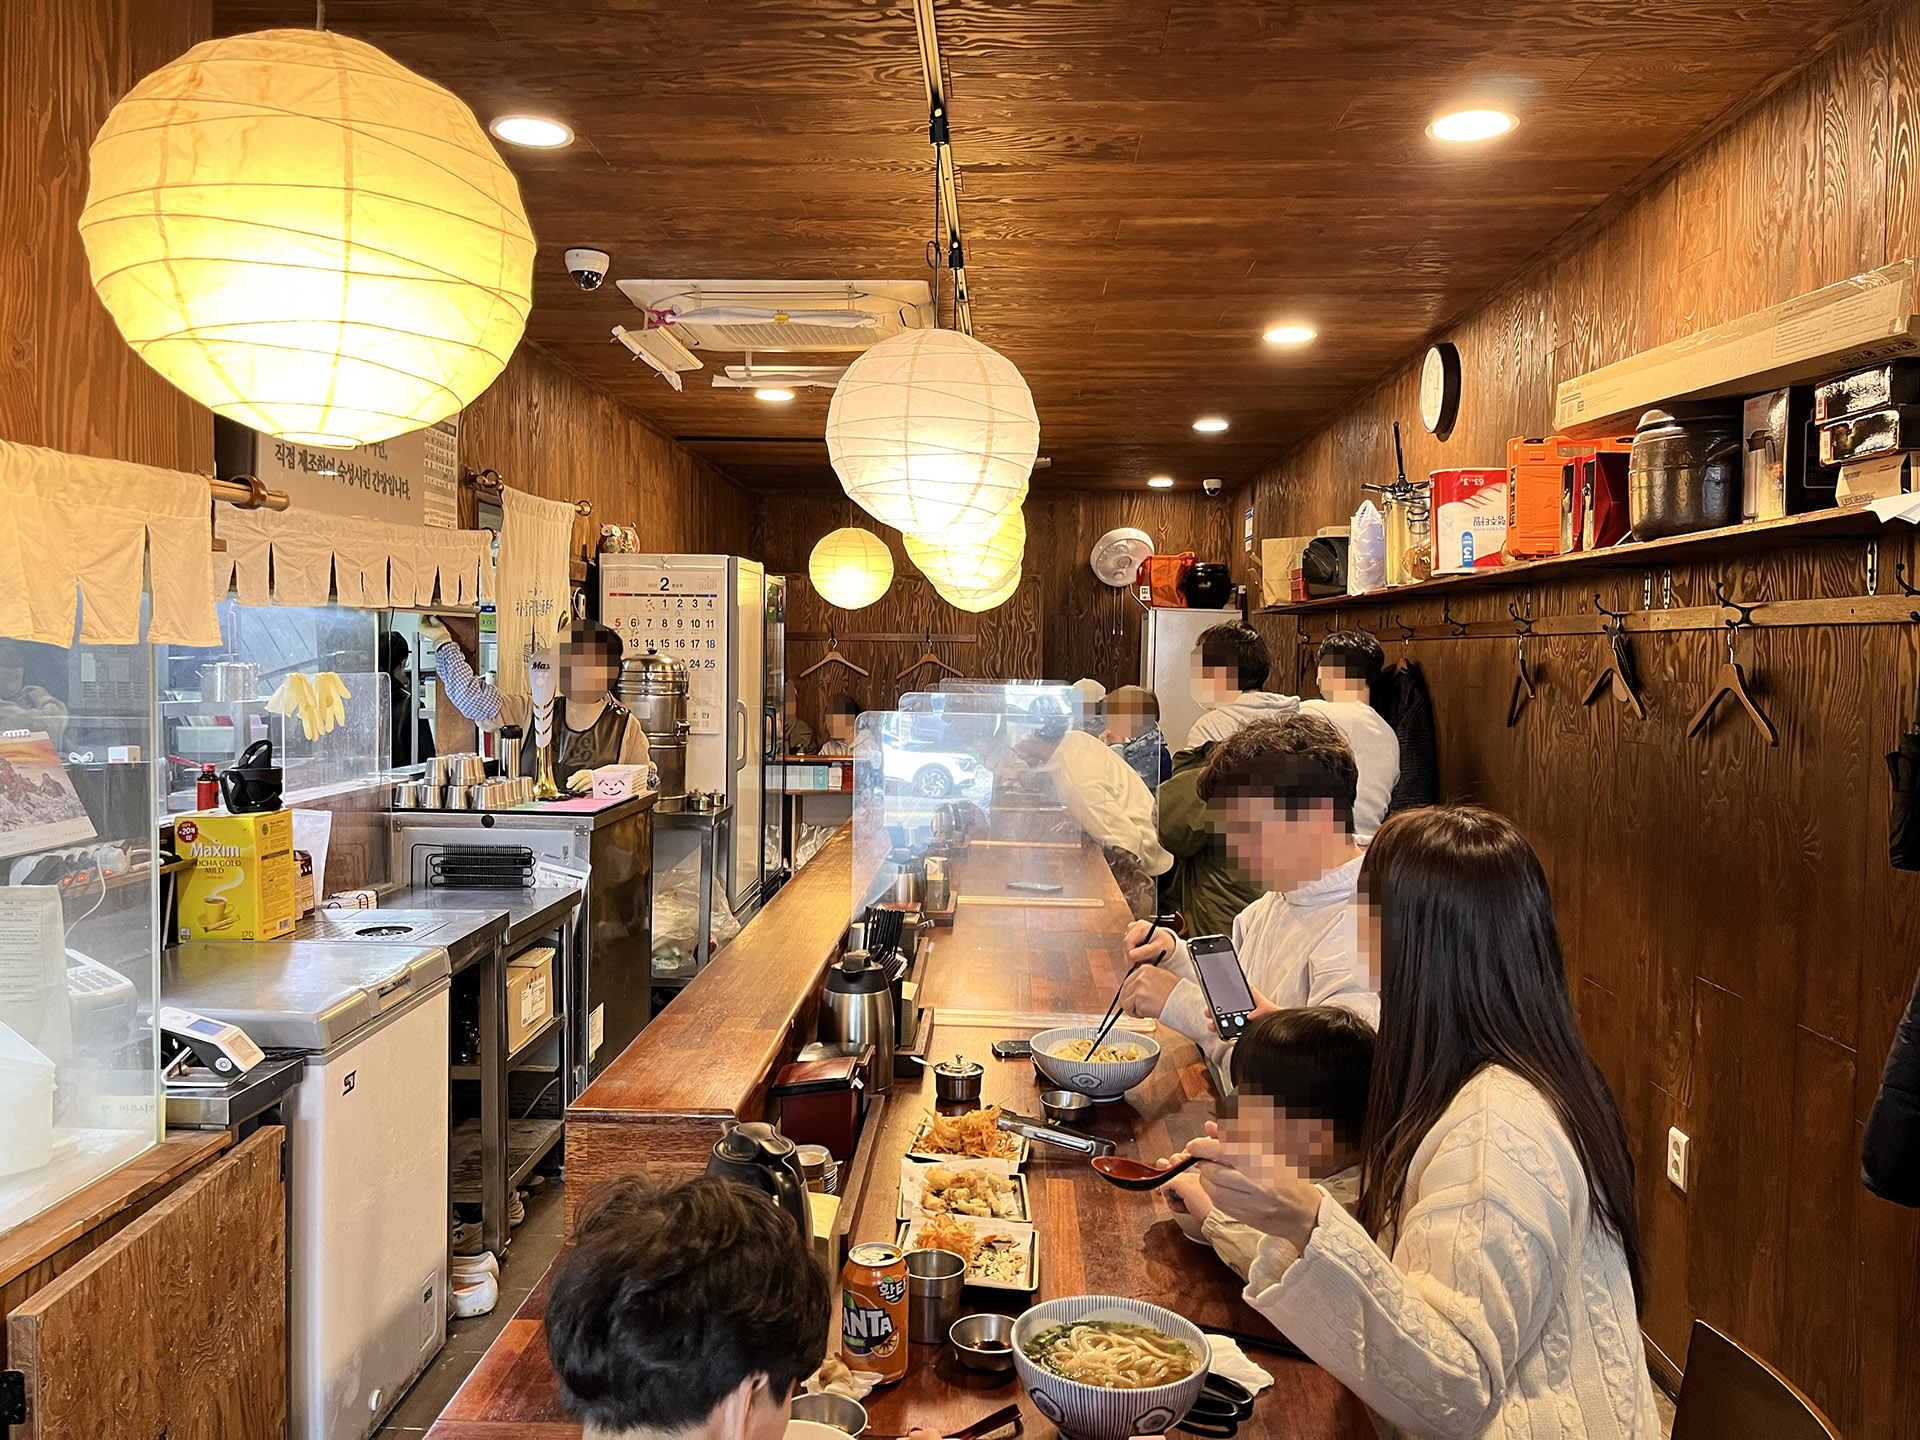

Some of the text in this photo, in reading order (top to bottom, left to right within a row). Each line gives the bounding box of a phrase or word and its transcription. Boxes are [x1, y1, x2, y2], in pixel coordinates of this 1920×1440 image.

[275, 443, 296, 470] 직접
[337, 459, 371, 489] 숙성시킨
[372, 470, 411, 501] 간장입니다.
[1463, 547, 1472, 558] 3
[659, 577, 670, 591] 2
[662, 599, 713, 608] 1 2 3 4
[614, 618, 714, 628] 5 6 7 8 9 10 11
[629, 639, 716, 649] 13 14 15 16 17 18
[689, 660, 716, 669] 24 25
[190, 841, 241, 858] Maxim
[196, 860, 219, 868] OCHA
[204, 867, 225, 875] MILD
[878, 1276, 906, 1299] 환타
[842, 1306, 893, 1338] ANTA
